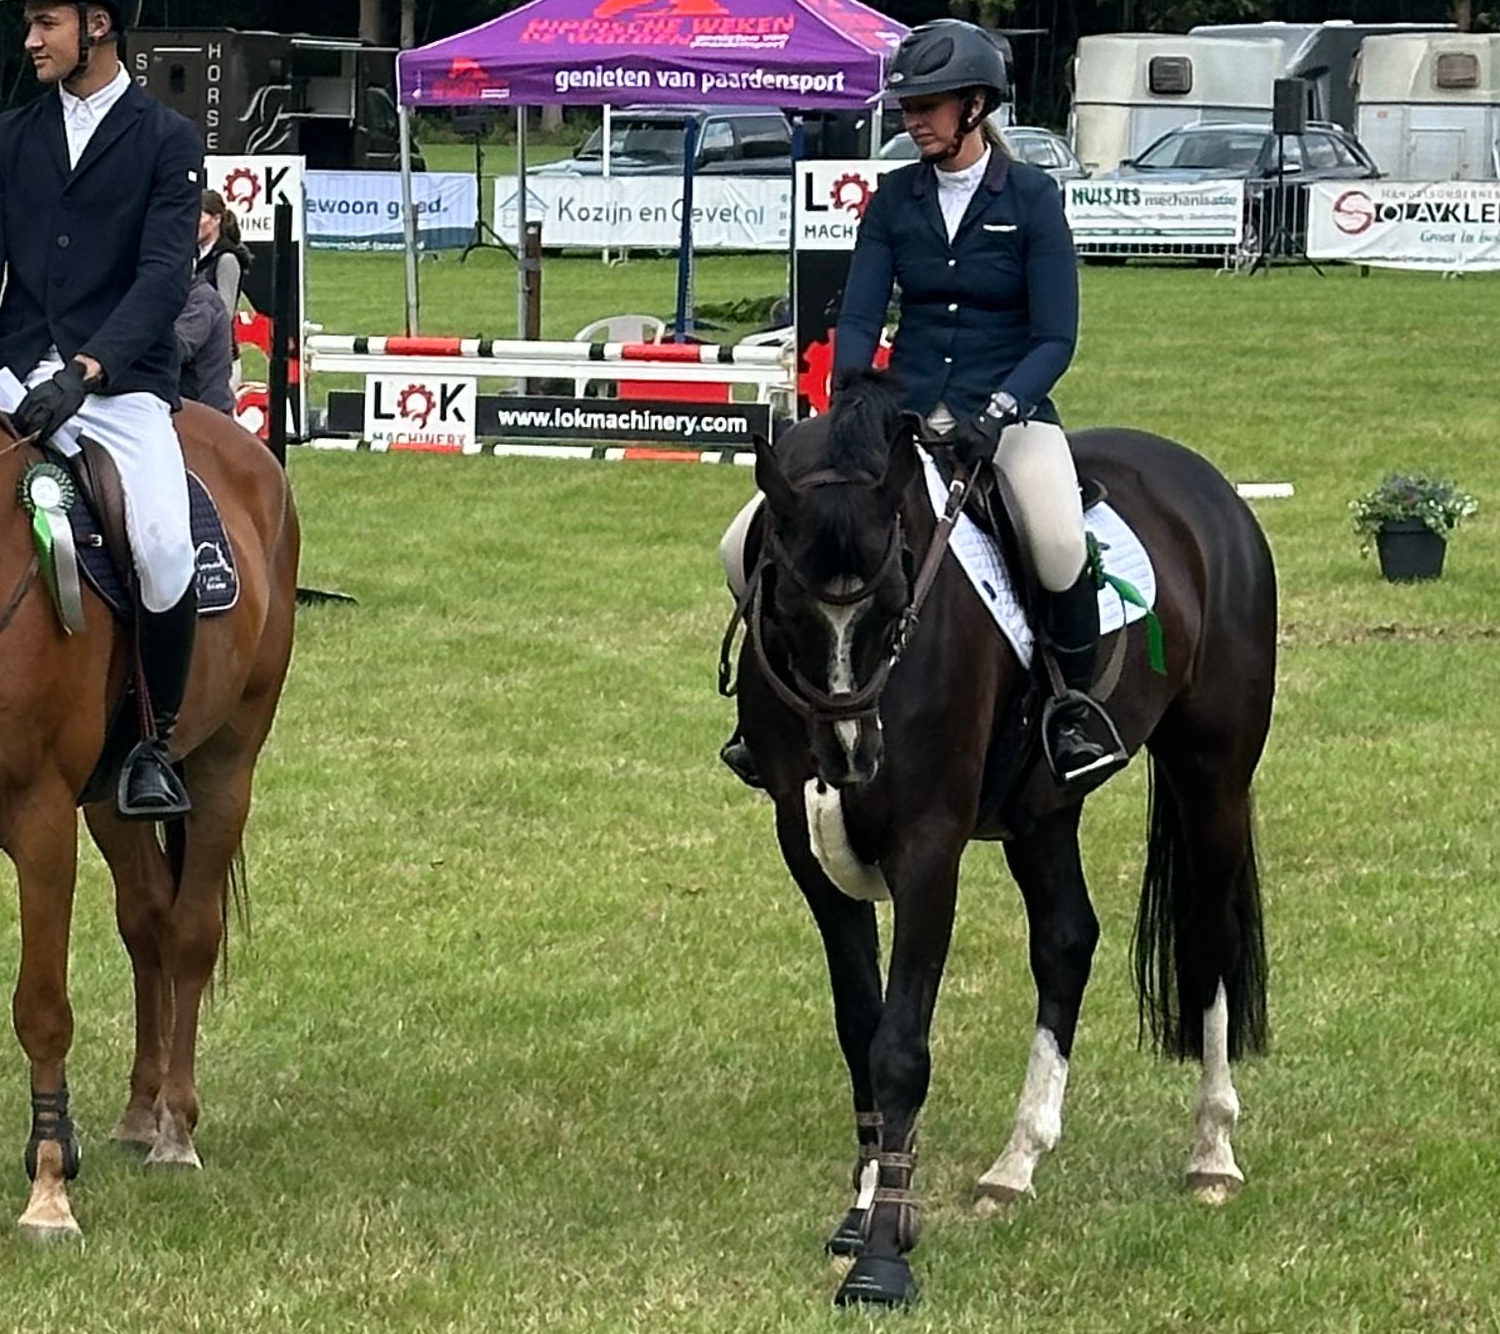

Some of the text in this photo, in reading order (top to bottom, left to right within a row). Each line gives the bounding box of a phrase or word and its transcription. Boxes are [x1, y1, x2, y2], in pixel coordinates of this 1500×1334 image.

[555, 65, 845, 94] genieten van paardensport
[206, 42, 221, 149] HORSE
[306, 201, 378, 215] ewoon
[558, 197, 631, 226] Kozijn
[639, 206, 667, 222] en
[804, 224, 853, 239] MACH
[373, 381, 468, 430] LOK
[498, 408, 748, 436] www.lokmachinery.com
